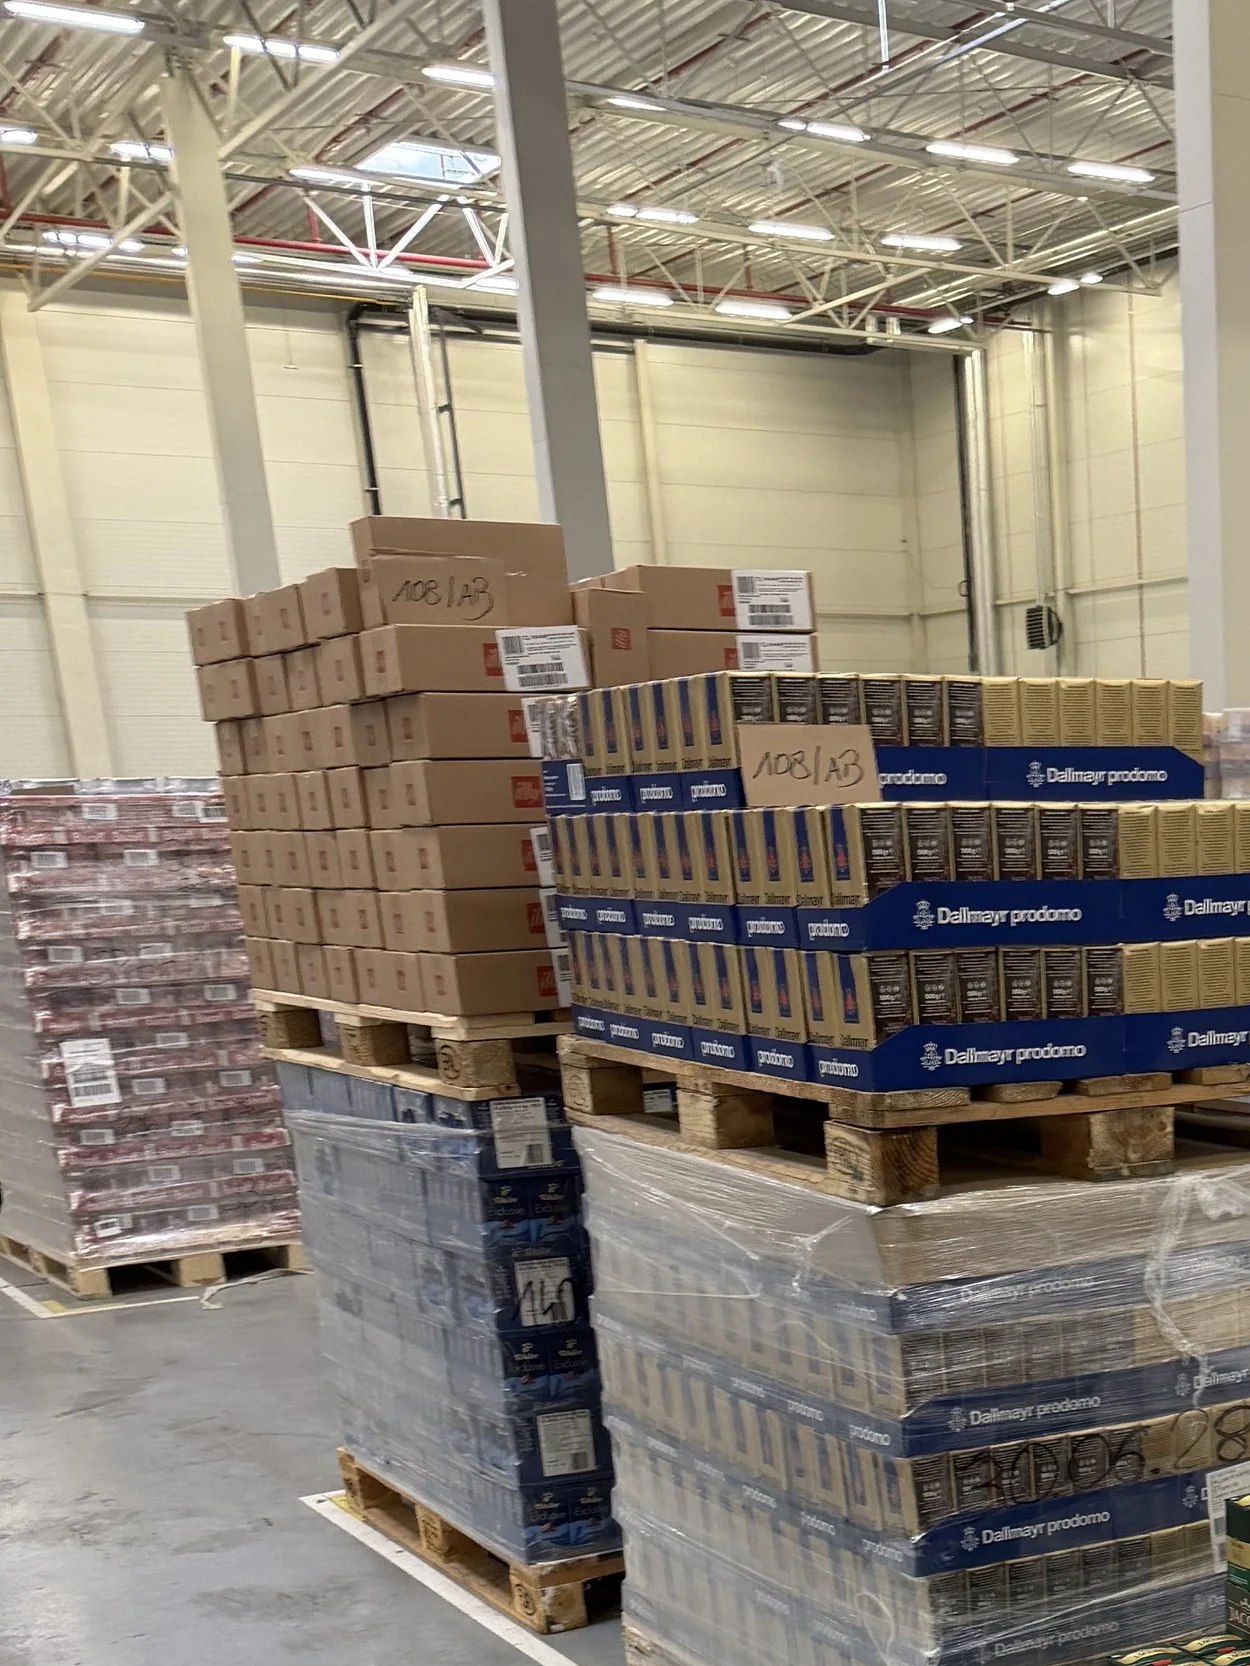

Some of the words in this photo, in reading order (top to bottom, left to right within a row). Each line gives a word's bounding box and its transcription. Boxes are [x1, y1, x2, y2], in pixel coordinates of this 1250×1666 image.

[1046, 767, 1107, 786] Dallmayr
[1108, 767, 1168, 786] prodomo
[936, 907, 1009, 929] Dallmayr
[1010, 905, 1082, 926] prodomo
[1184, 898, 1247, 917] Dallmayr
[1187, 1031, 1250, 1048] Dallmayr
[945, 1048, 1015, 1066] Dallmayr
[1016, 1043, 1087, 1064] prodomo
[1193, 1368, 1249, 1389] Dallmayr
[969, 1405, 1035, 1426] Dallmayr
[1036, 1394, 1100, 1416] prodomo
[849, 1423, 891, 1445] prodomo
[982, 1520, 1046, 1546] Dallmayr
[1047, 1511, 1111, 1536] prodomo
[994, 1636, 1055, 1658] Dallmayr
[1056, 1620, 1119, 1644] prodomo
